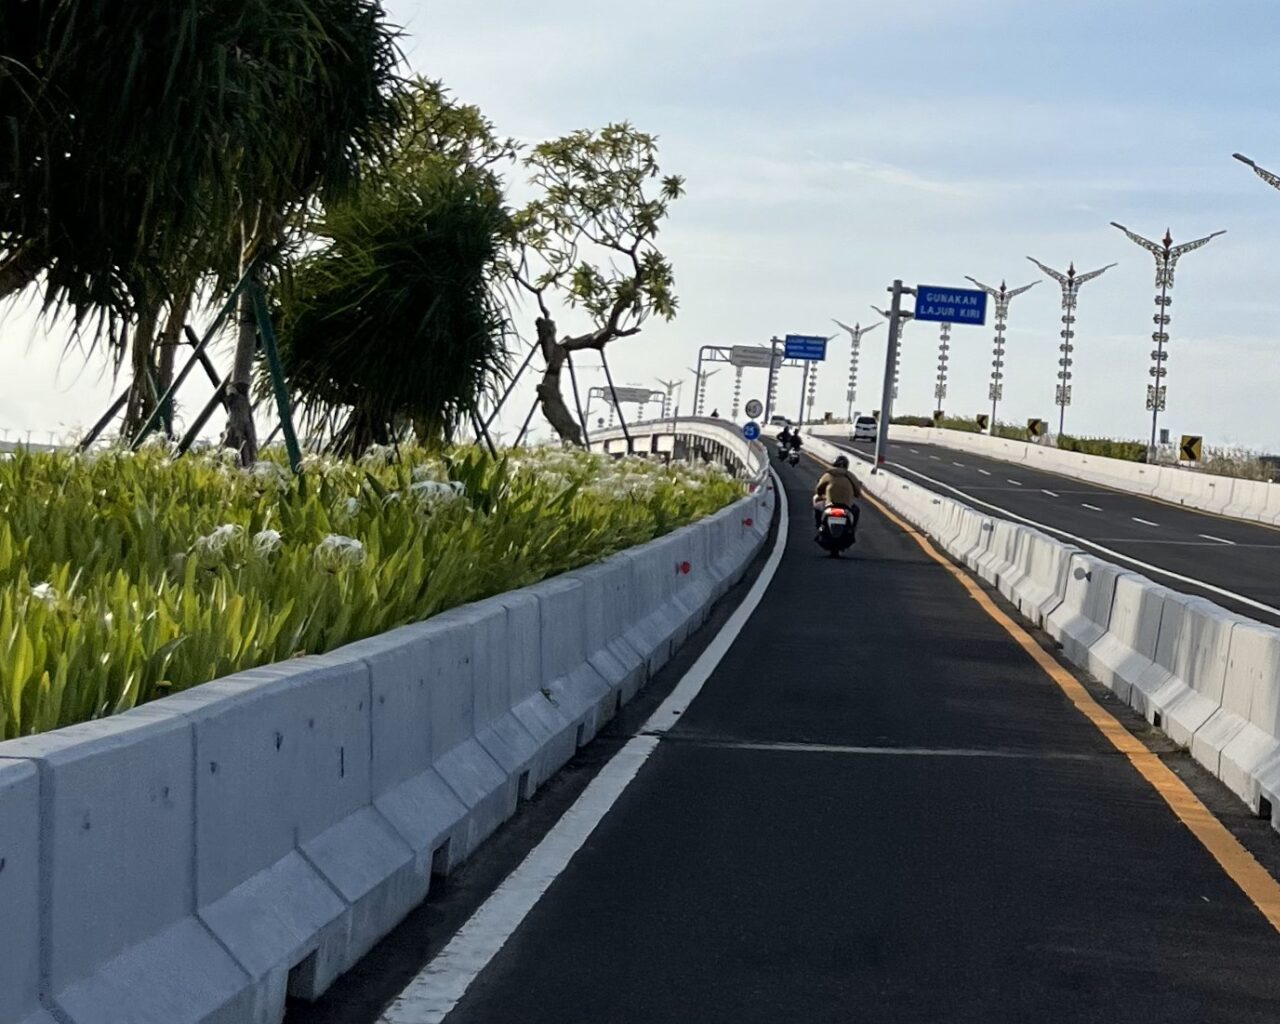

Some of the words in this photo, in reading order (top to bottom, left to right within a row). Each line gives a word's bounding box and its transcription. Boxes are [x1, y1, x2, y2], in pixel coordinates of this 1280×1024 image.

[926, 293, 978, 305] GUNAKAN
[920, 305, 955, 317] LAJUR
[959, 308, 980, 319] KIRI
